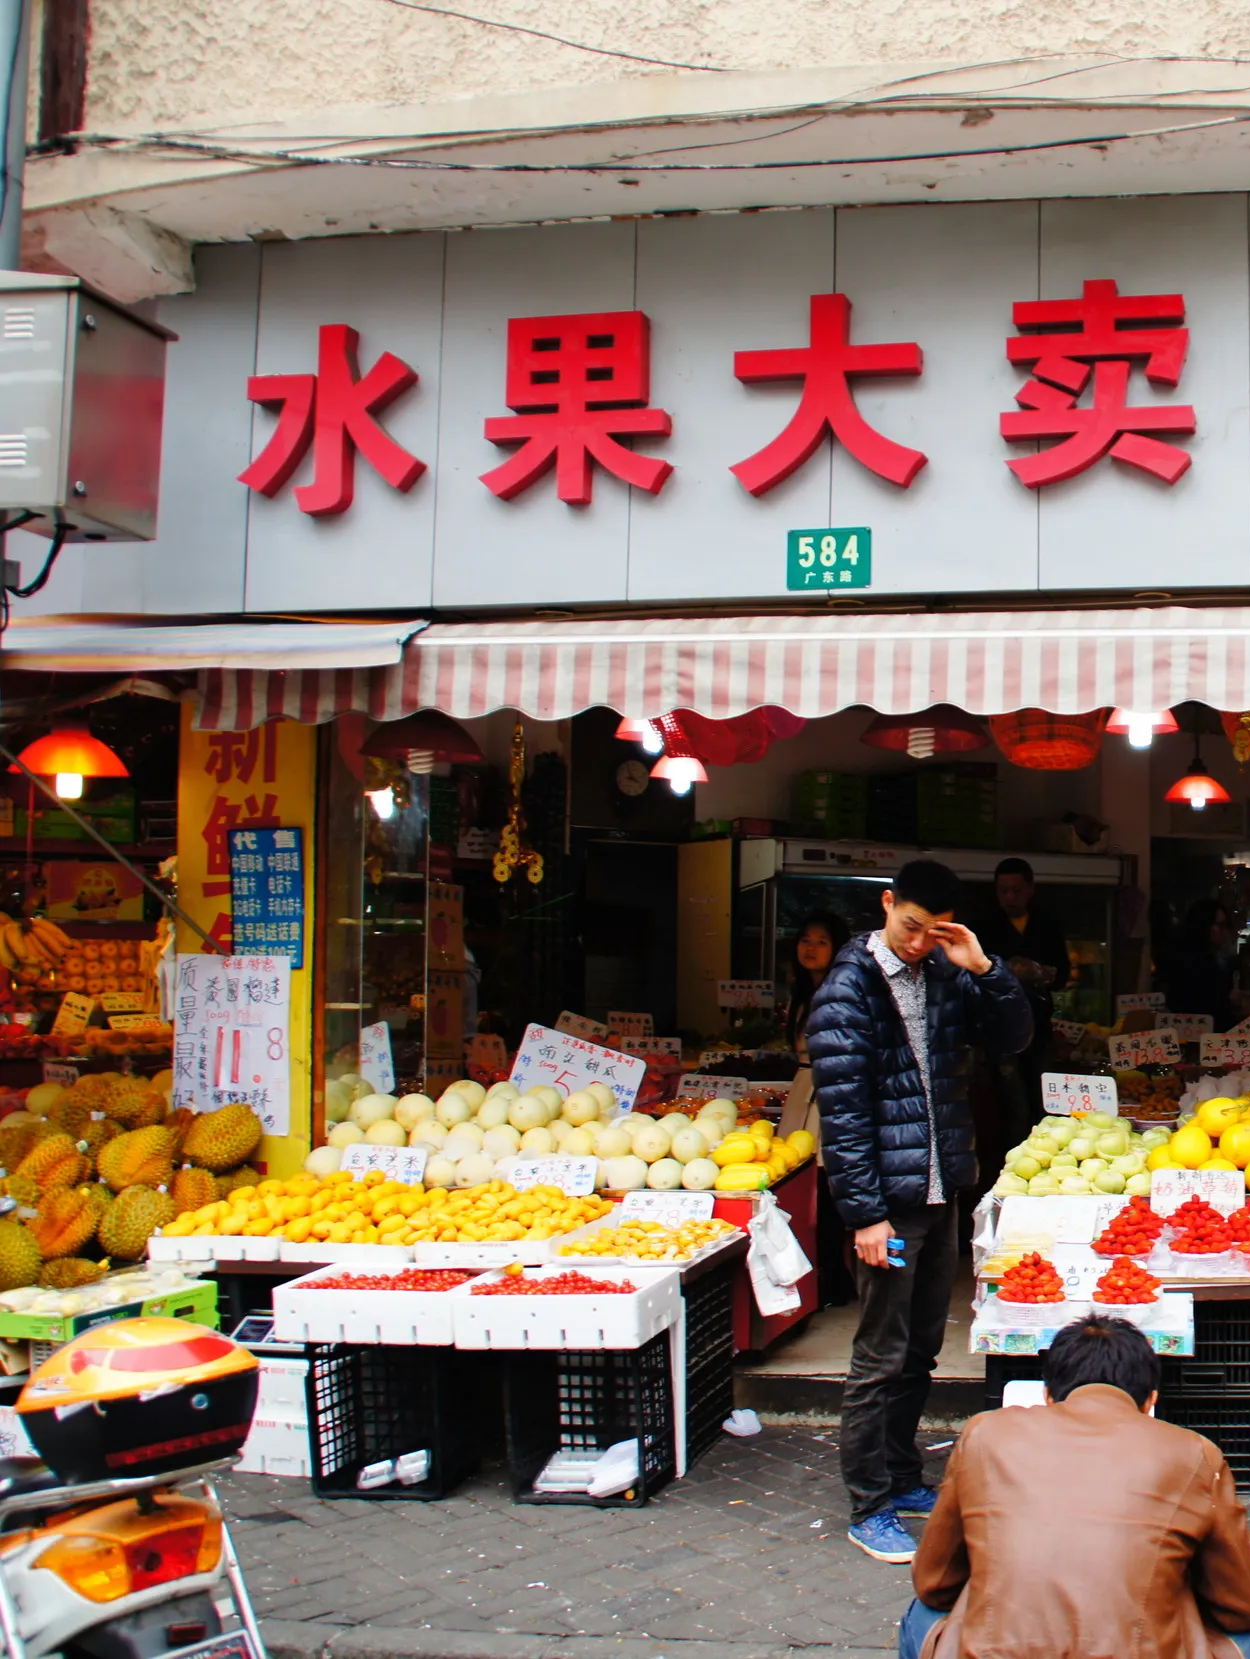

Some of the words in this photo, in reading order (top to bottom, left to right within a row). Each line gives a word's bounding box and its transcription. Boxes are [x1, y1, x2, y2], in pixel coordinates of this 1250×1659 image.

[798, 534, 859, 568] 584
[804, 569, 852, 584] 广东路
[233, 830, 296, 850] 代售
